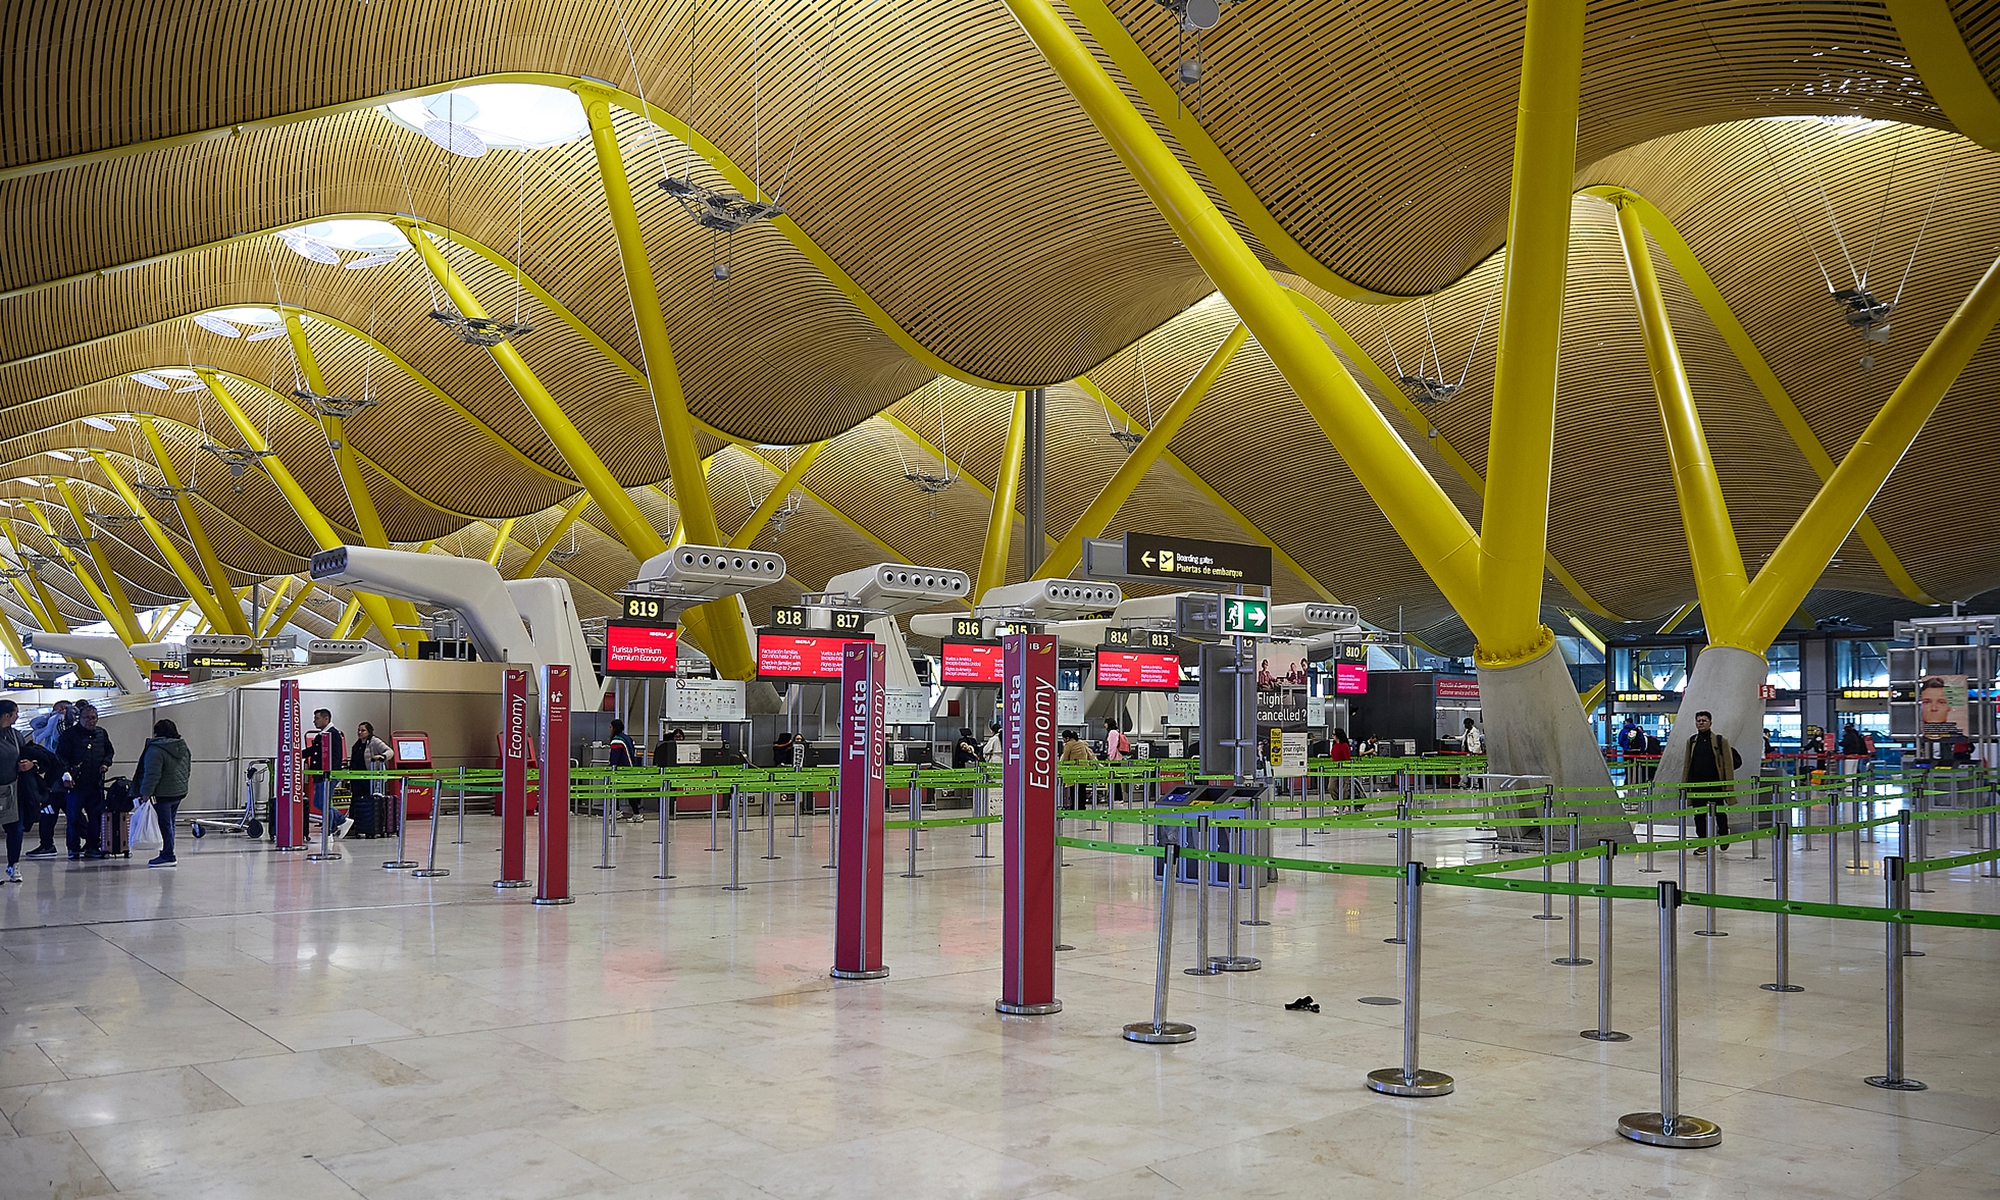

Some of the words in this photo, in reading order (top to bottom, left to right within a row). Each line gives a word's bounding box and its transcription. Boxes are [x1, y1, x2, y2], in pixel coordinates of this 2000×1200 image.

[1176, 552, 1198, 565] Boarding
[1199, 556, 1213, 565] gates
[1176, 563, 1202, 573] Puertas
[1202, 566, 1211, 574] de
[1212, 567, 1243, 578] embarque
[628, 600, 659, 617] 819
[776, 610, 802, 625] 818
[836, 614, 860, 628] 817
[957, 621, 979, 635] 816
[1110, 630, 1128, 644] 814
[1151, 633, 1169, 646] 813
[612, 645, 633, 653] Turista
[634, 647, 661, 655] Premium
[1345, 645, 1360, 658] 810
[162, 661, 181, 669] 789
[612, 653, 639, 661] Premium
[640, 654, 667, 664] Economy
[1257, 692, 1284, 708] Flight
[282, 699, 290, 752] Premium
[508, 693, 527, 759] Economy
[849, 680, 867, 760] Turista
[1008, 675, 1021, 766] Turista
[871, 681, 886, 780] Economy
[1029, 676, 1057, 789] Economy
[282, 755, 290, 796] Turista
